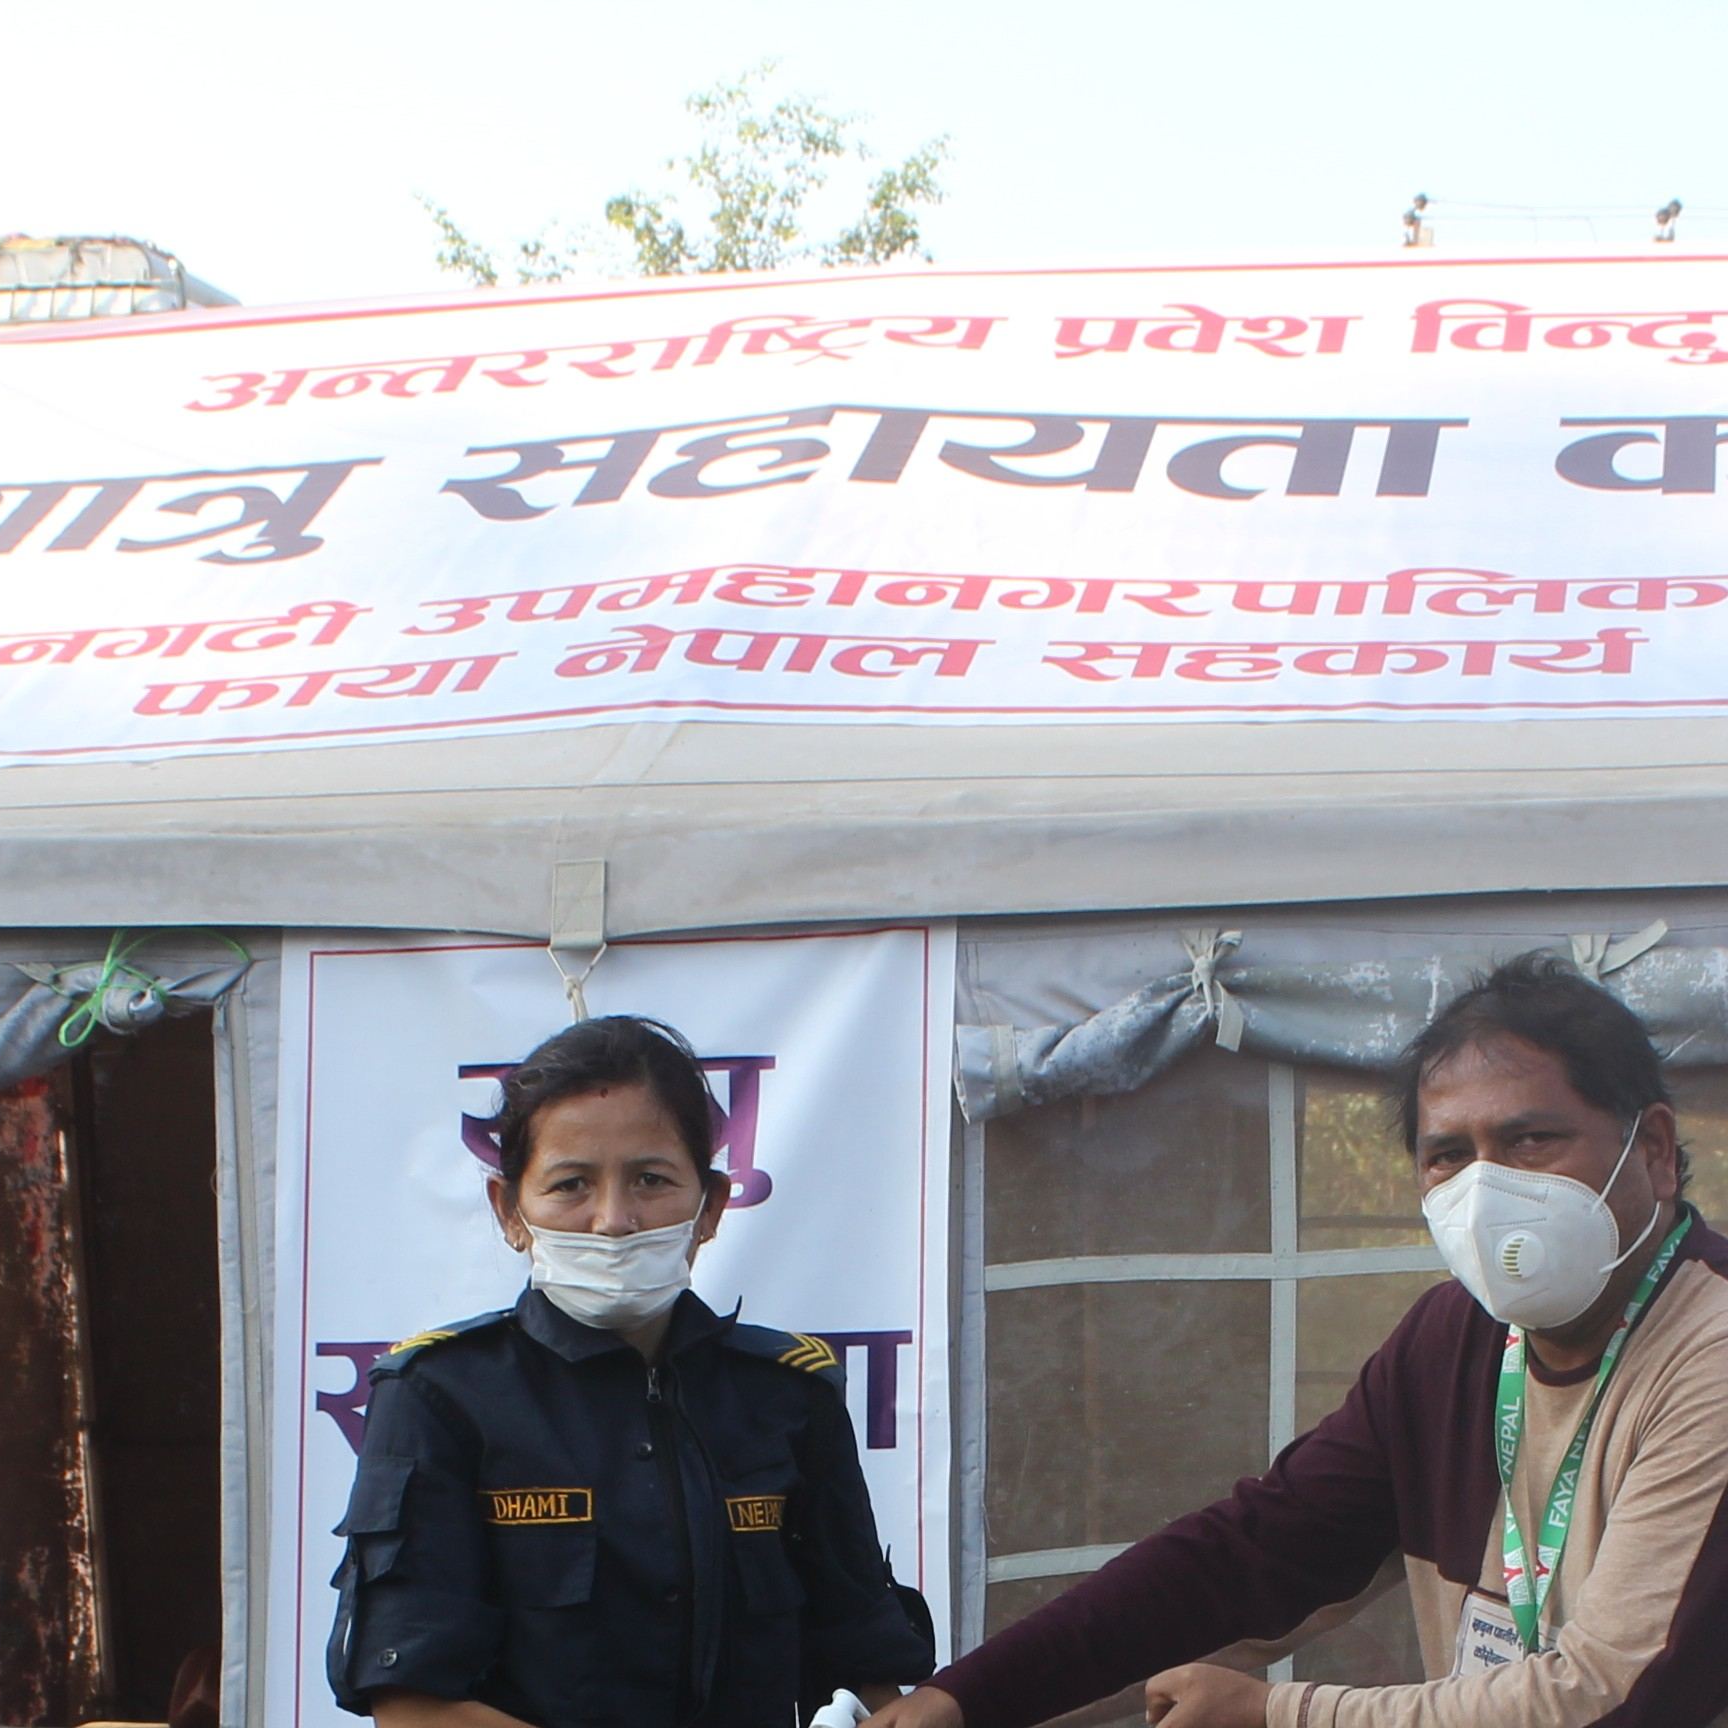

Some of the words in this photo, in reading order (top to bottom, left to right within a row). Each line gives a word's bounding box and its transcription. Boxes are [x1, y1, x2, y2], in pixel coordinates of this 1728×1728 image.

[1052, 304, 1363, 358] प्रवेश
[439, 404, 1470, 521] सहायता
[132, 652, 519, 717] फाया
[554, 624, 997, 678] नेपाल
[1042, 627, 1650, 681] सहकार्य
[1501, 1396, 1521, 1475] NEPAL
[493, 1494, 569, 1519] DHAMI
[736, 1502, 783, 1527] NEPA
[1548, 1468, 1578, 1529] FAYA
